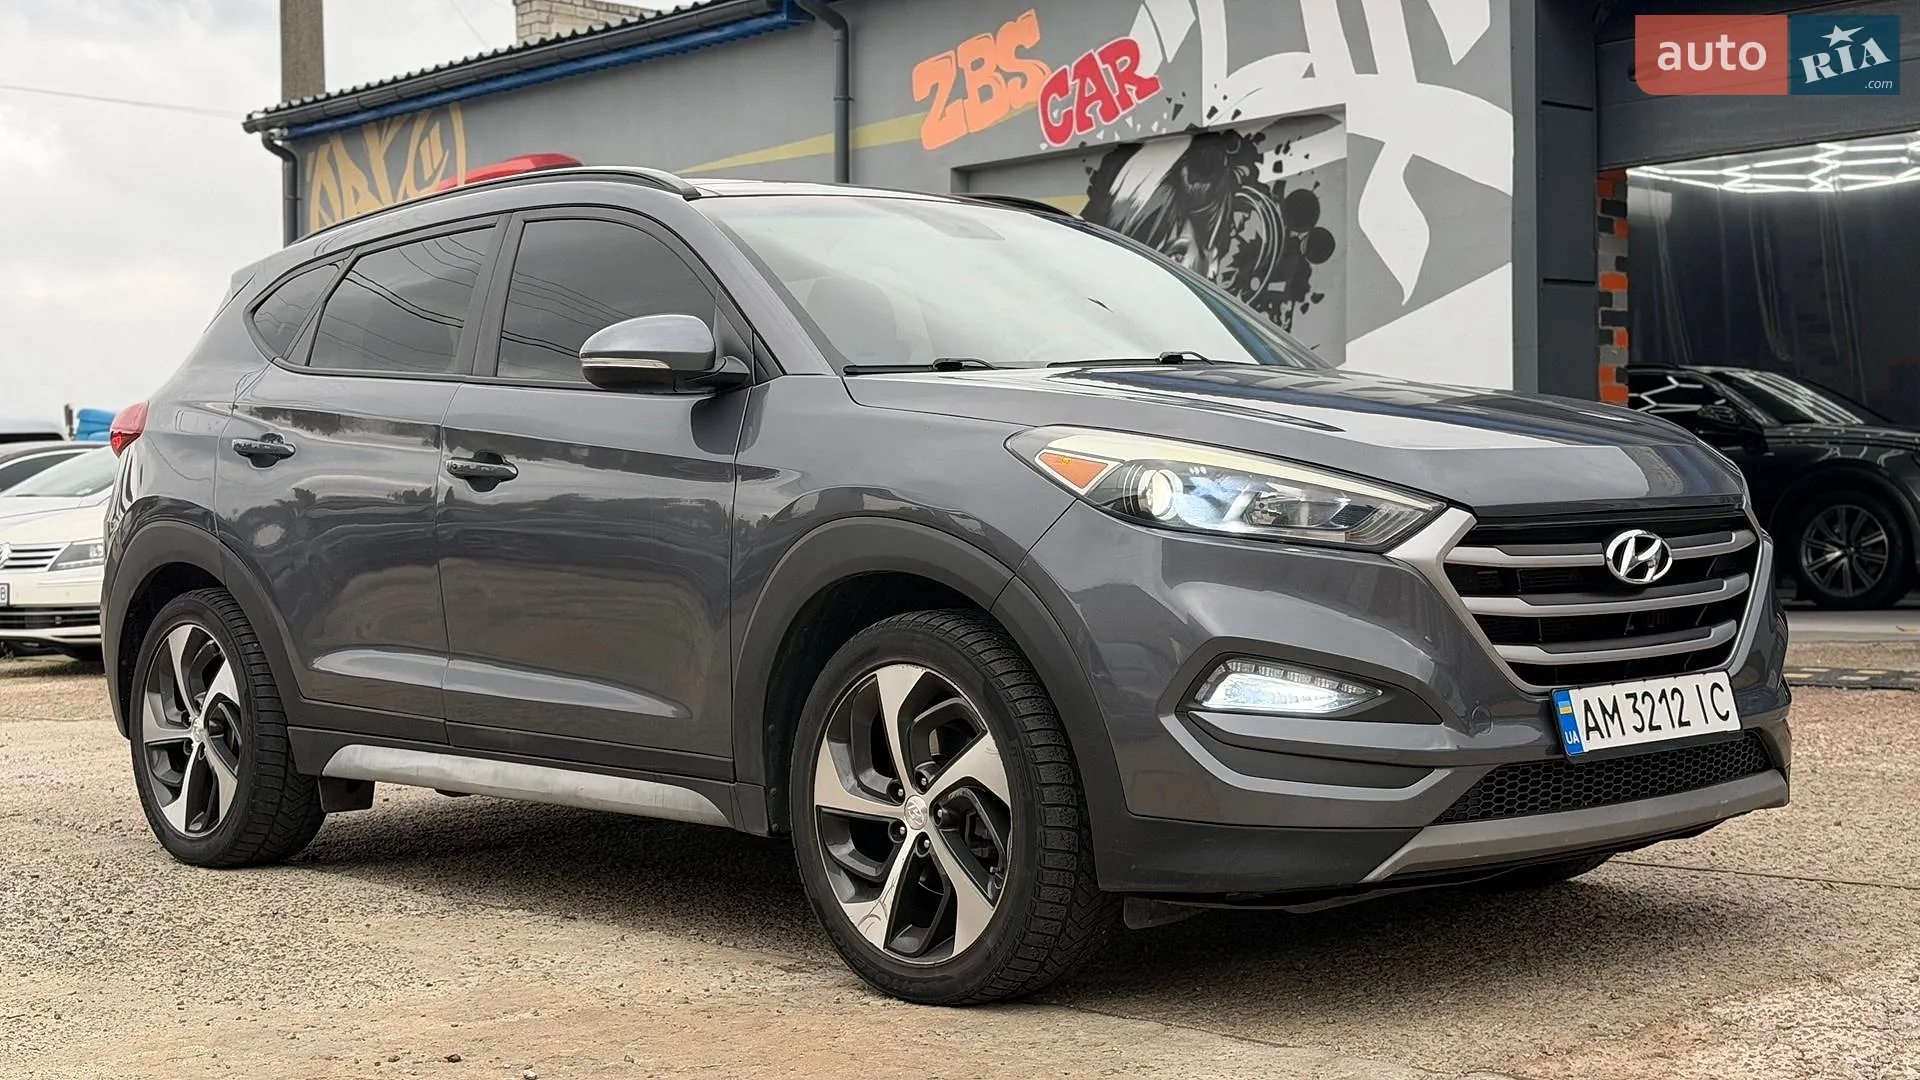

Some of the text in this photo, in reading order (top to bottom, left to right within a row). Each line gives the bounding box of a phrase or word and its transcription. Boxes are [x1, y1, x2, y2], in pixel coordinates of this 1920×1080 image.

[912, 8, 1163, 150] ZBS CAR
[1565, 730, 1580, 745] UA
[1583, 682, 1730, 741] AM 3212 IC
